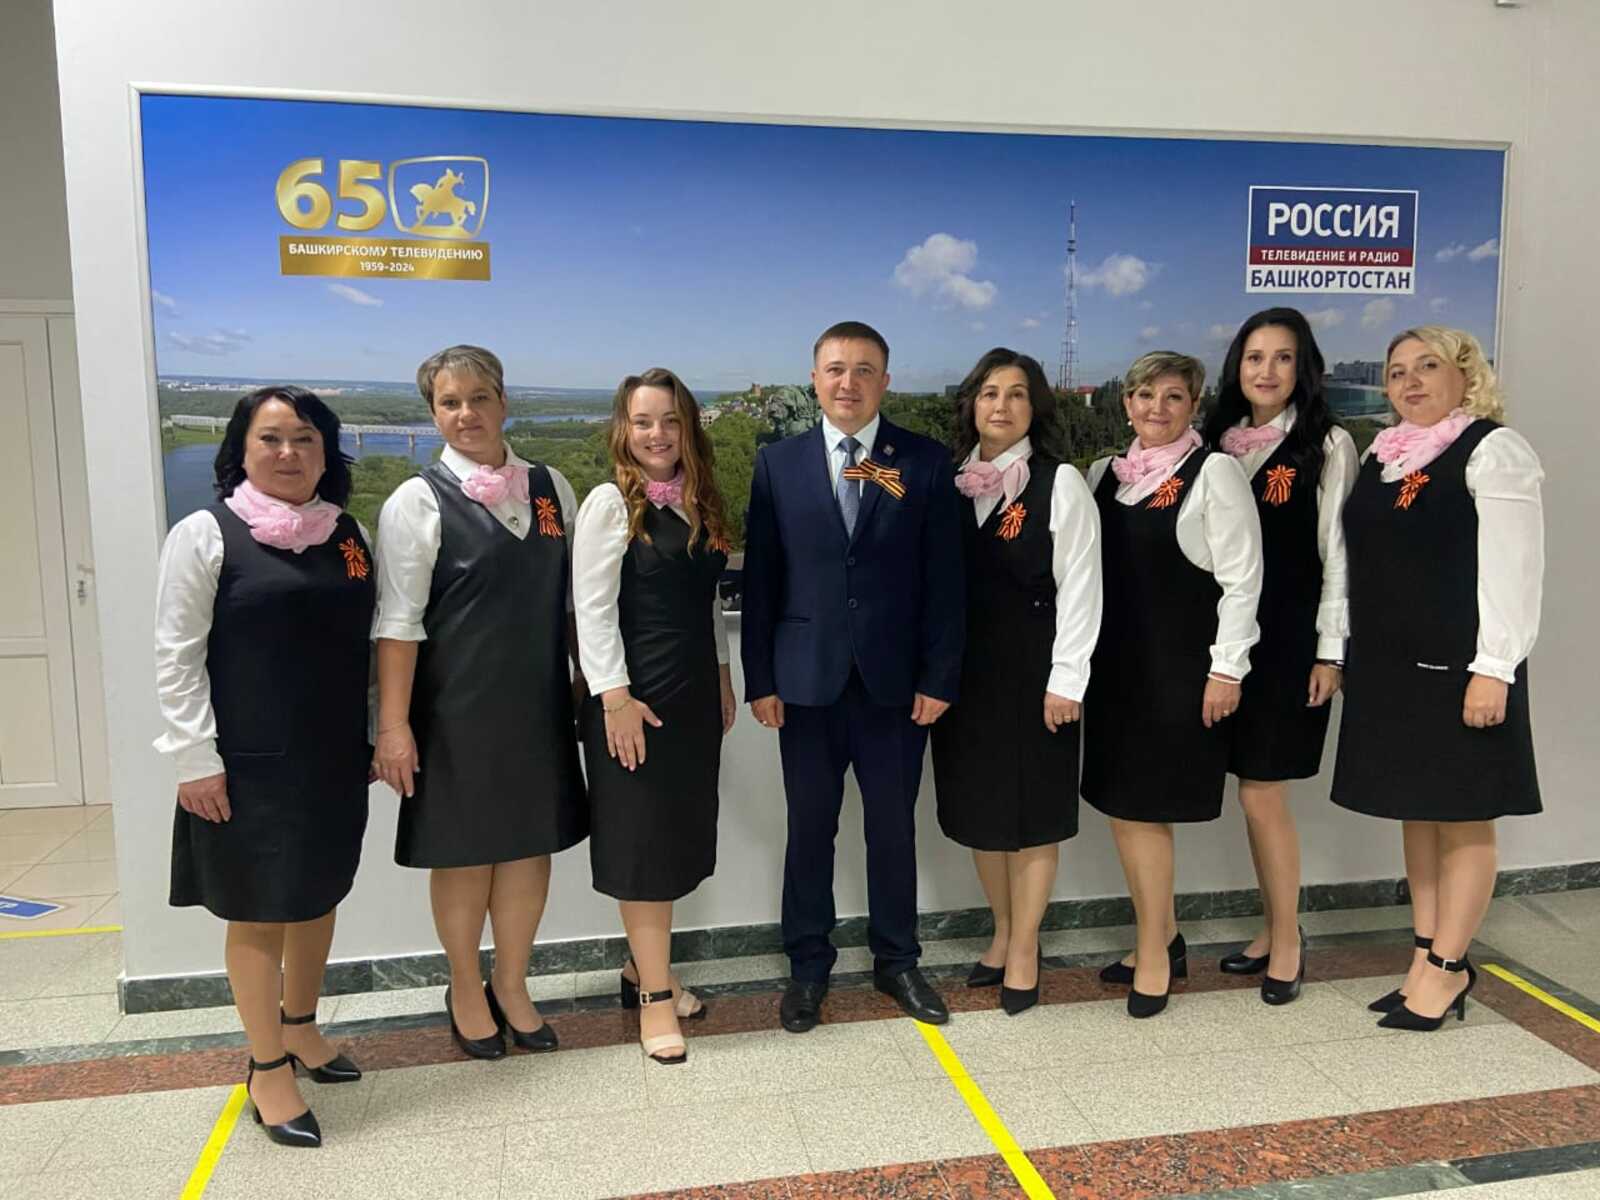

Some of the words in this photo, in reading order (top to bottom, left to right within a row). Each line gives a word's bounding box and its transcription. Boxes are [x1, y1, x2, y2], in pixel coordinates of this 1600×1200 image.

[276, 158, 387, 231] 65
[1268, 203, 1400, 238] РОССИЯ
[288, 243, 387, 257] БАШКИРСКОМУ
[391, 247, 484, 260] ТЕЛЕВИДЕНИЮ
[1261, 249, 1345, 263] ТЕЛЕВИДЕНИЕ
[1348, 251, 1357, 262] И
[1359, 251, 1400, 264] РАДИО
[360, 261, 415, 272] 1959-2024
[1251, 270, 1411, 289] БАШКОРТОСТАН
